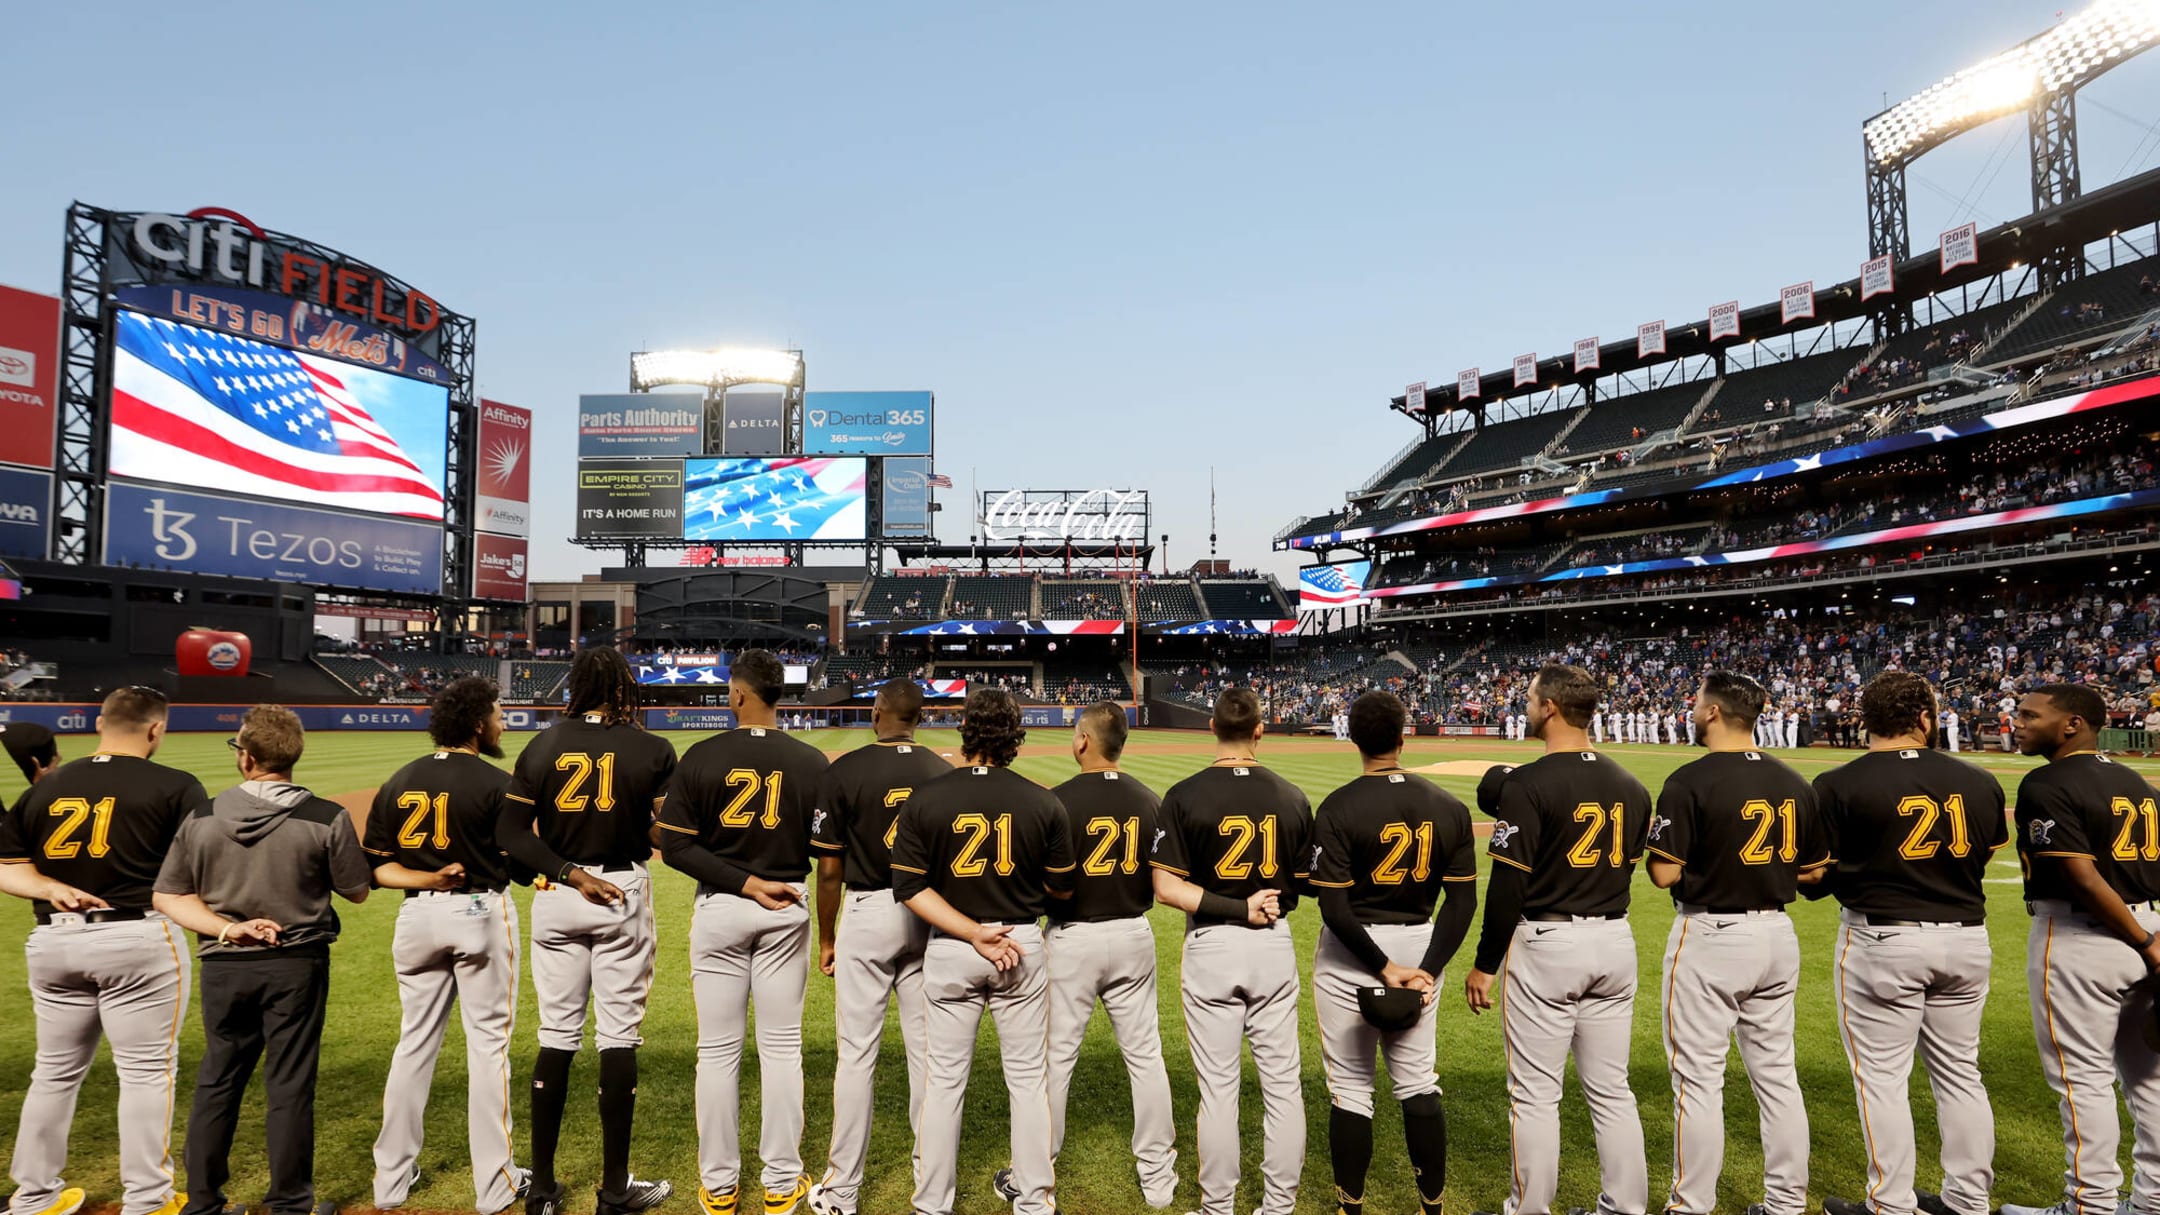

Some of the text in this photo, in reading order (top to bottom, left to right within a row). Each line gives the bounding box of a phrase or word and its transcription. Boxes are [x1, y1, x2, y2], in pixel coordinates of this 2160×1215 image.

[1945, 228, 1970, 245] 2016
[134, 213, 439, 332] citi FIELD
[1865, 259, 1887, 274] 2015
[1784, 286, 1809, 299] 2006
[1712, 305, 1735, 317] 2000
[172, 290, 389, 366] LET'S GO Mets
[1642, 324, 1660, 334] 1999
[416, 365, 437, 379] citi
[483, 406, 529, 429] Affinity
[581, 408, 699, 427] Parts Authority
[741, 419, 779, 428] DELTA
[829, 409, 925, 426] Dental365
[830, 434, 849, 443] 365
[882, 431, 906, 445] Smile
[585, 475, 639, 483] EMPIRE
[493, 510, 524, 525] Affinity
[583, 508, 676, 518] IT'S A HOME RUN
[984, 489, 1147, 540] Coca-Cola
[217, 516, 362, 569] Tezos
[480, 553, 512, 566] Jakes
[717, 556, 740, 565] new
[743, 555, 791, 565] balance
[382, 565, 407, 574] Collect
[656, 655, 717, 665] citi PAVILION
[57, 713, 86, 729] citi
[358, 714, 410, 724] DELTA
[555, 753, 615, 812] 21
[719, 769, 783, 829] 21
[44, 797, 115, 859] 21
[397, 791, 450, 849] 21
[883, 788, 912, 849] 2
[1897, 794, 1971, 860] 21
[1567, 802, 1623, 867] 21
[1739, 799, 1798, 865] 21
[2111, 797, 2160, 862] 21
[951, 813, 1015, 877] 21
[1083, 816, 1140, 876] 21
[1214, 815, 1279, 879] 21
[1371, 821, 1433, 885] 21
